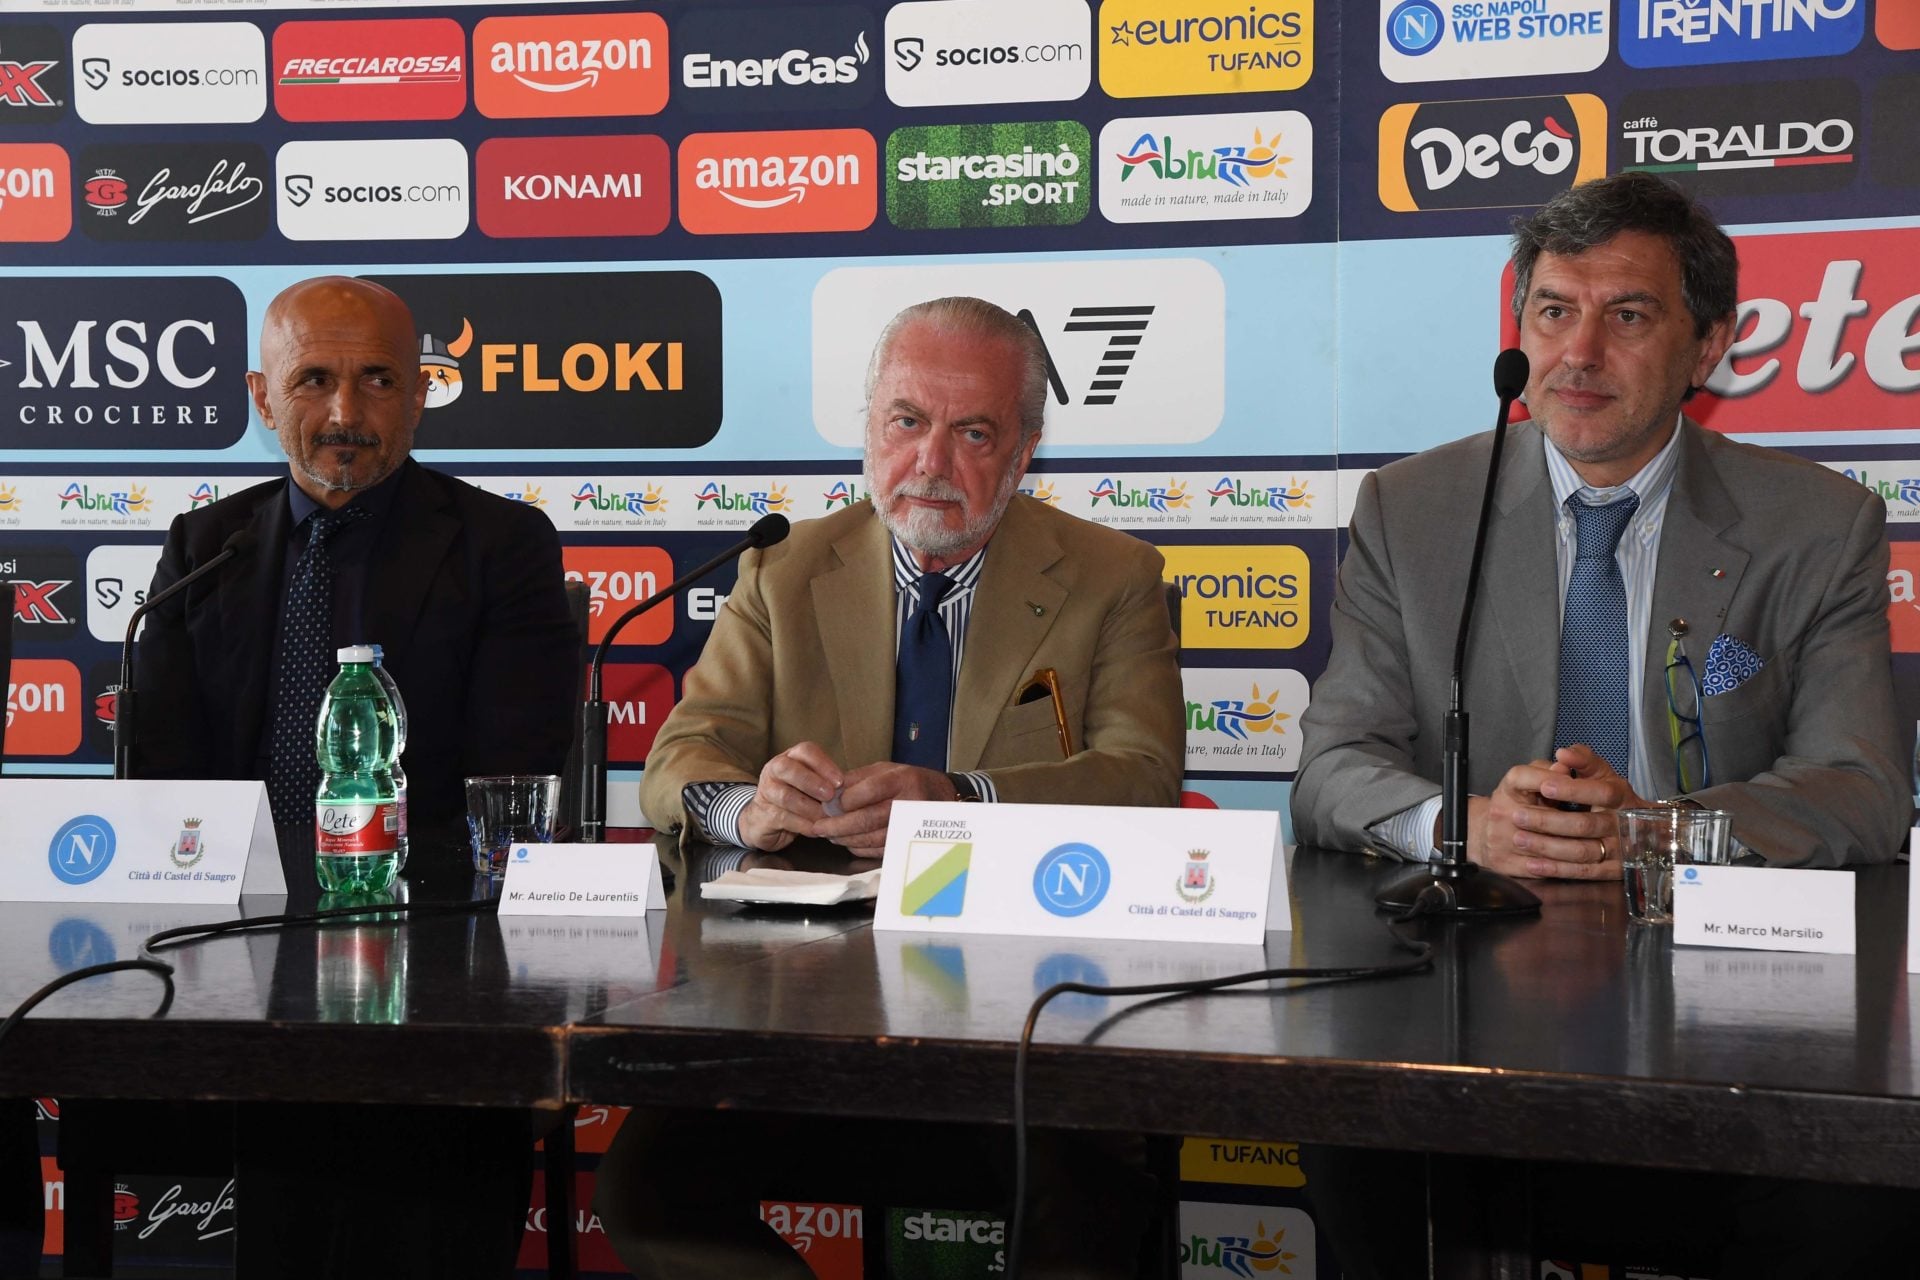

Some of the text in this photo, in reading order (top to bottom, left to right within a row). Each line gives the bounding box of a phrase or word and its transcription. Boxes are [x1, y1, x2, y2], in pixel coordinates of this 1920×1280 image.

[1452, 0, 1546, 19] SSC NAPOLI
[1135, 6, 1301, 45] euronics
[1452, 11, 1603, 43] WEB STORE
[283, 55, 461, 75] FRECCIAROSSA
[491, 38, 652, 73] amazon
[683, 49, 858, 88] EnerGas
[1207, 50, 1301, 72] TUFANO
[1623, 116, 1658, 131] caffè
[1623, 118, 1853, 163] TORALDO
[696, 154, 859, 190] amazon
[898, 145, 1079, 182] starcasinò
[128, 159, 263, 224] Garofalo
[504, 173, 642, 200] KONAMI
[1121, 188, 1289, 207] made in nature, made in Italy
[1703, 259, 1920, 397] ete
[17, 319, 217, 389] MSC
[482, 342, 683, 392] FLOKI
[19, 405, 219, 425] CROCIERE
[1174, 566, 1298, 599] ronics
[1206, 610, 1298, 628] TUFANO
[1212, 743, 1243, 756] made
[1247, 744, 1258, 756] in
[1261, 744, 1286, 759] Italy
[914, 830, 972, 840] ABRUZZO
[922, 819, 966, 829] REGIONE
[66, 834, 98, 864] N
[128, 870, 236, 883] Città di Castel di Sangro
[1054, 863, 1089, 897] N
[509, 891, 639, 903] Mr. Aurelio De Laurentiis
[1128, 903, 1257, 921] Città di Castel di Sangro
[1704, 923, 1824, 940] Mr. Marco Marsilio
[138, 1178, 234, 1240] Garofa
[903, 1212, 1005, 1244] starca
